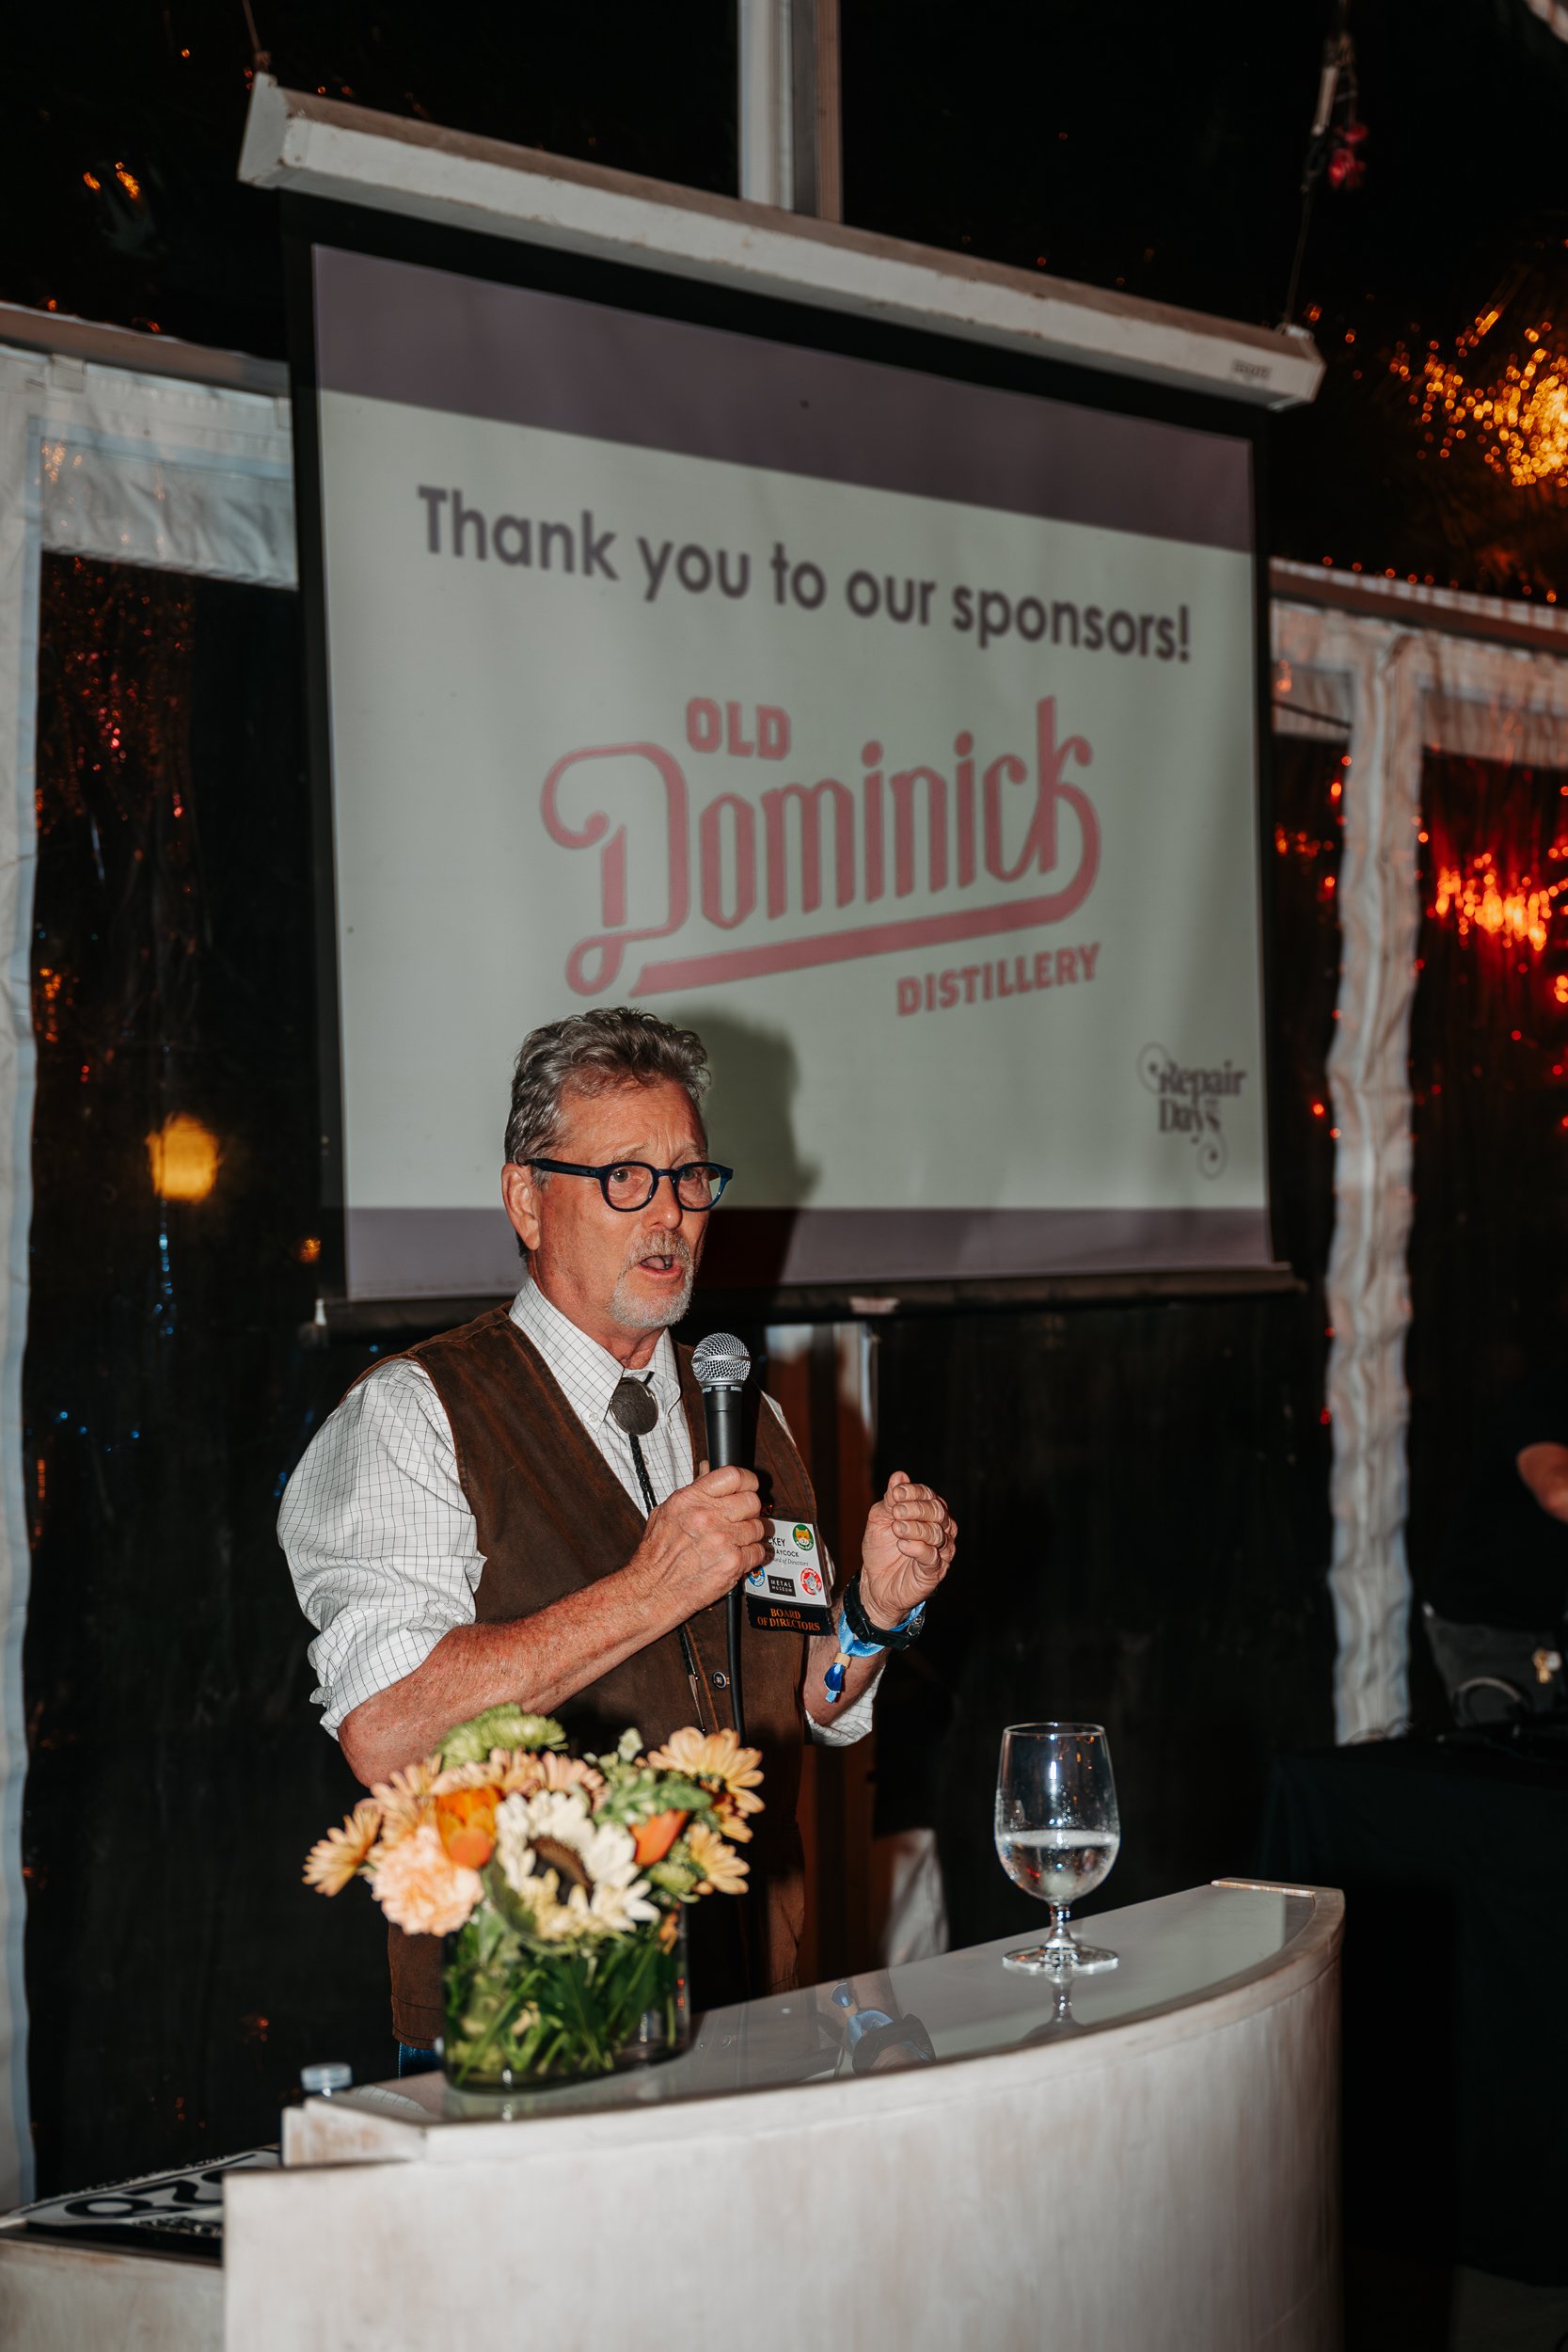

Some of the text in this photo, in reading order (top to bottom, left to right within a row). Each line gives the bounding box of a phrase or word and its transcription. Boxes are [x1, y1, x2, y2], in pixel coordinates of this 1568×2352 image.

[418, 485, 1191, 663] Thank you to our sponsors!
[686, 697, 791, 760] OLD
[540, 695, 1101, 998] Dominick
[897, 943, 1101, 1017] DISTILLERY
[770, 1580, 792, 1588] METAL
[770, 1608, 801, 1620] BOARD
[757, 1616, 821, 1631] OF DIRECTORS
